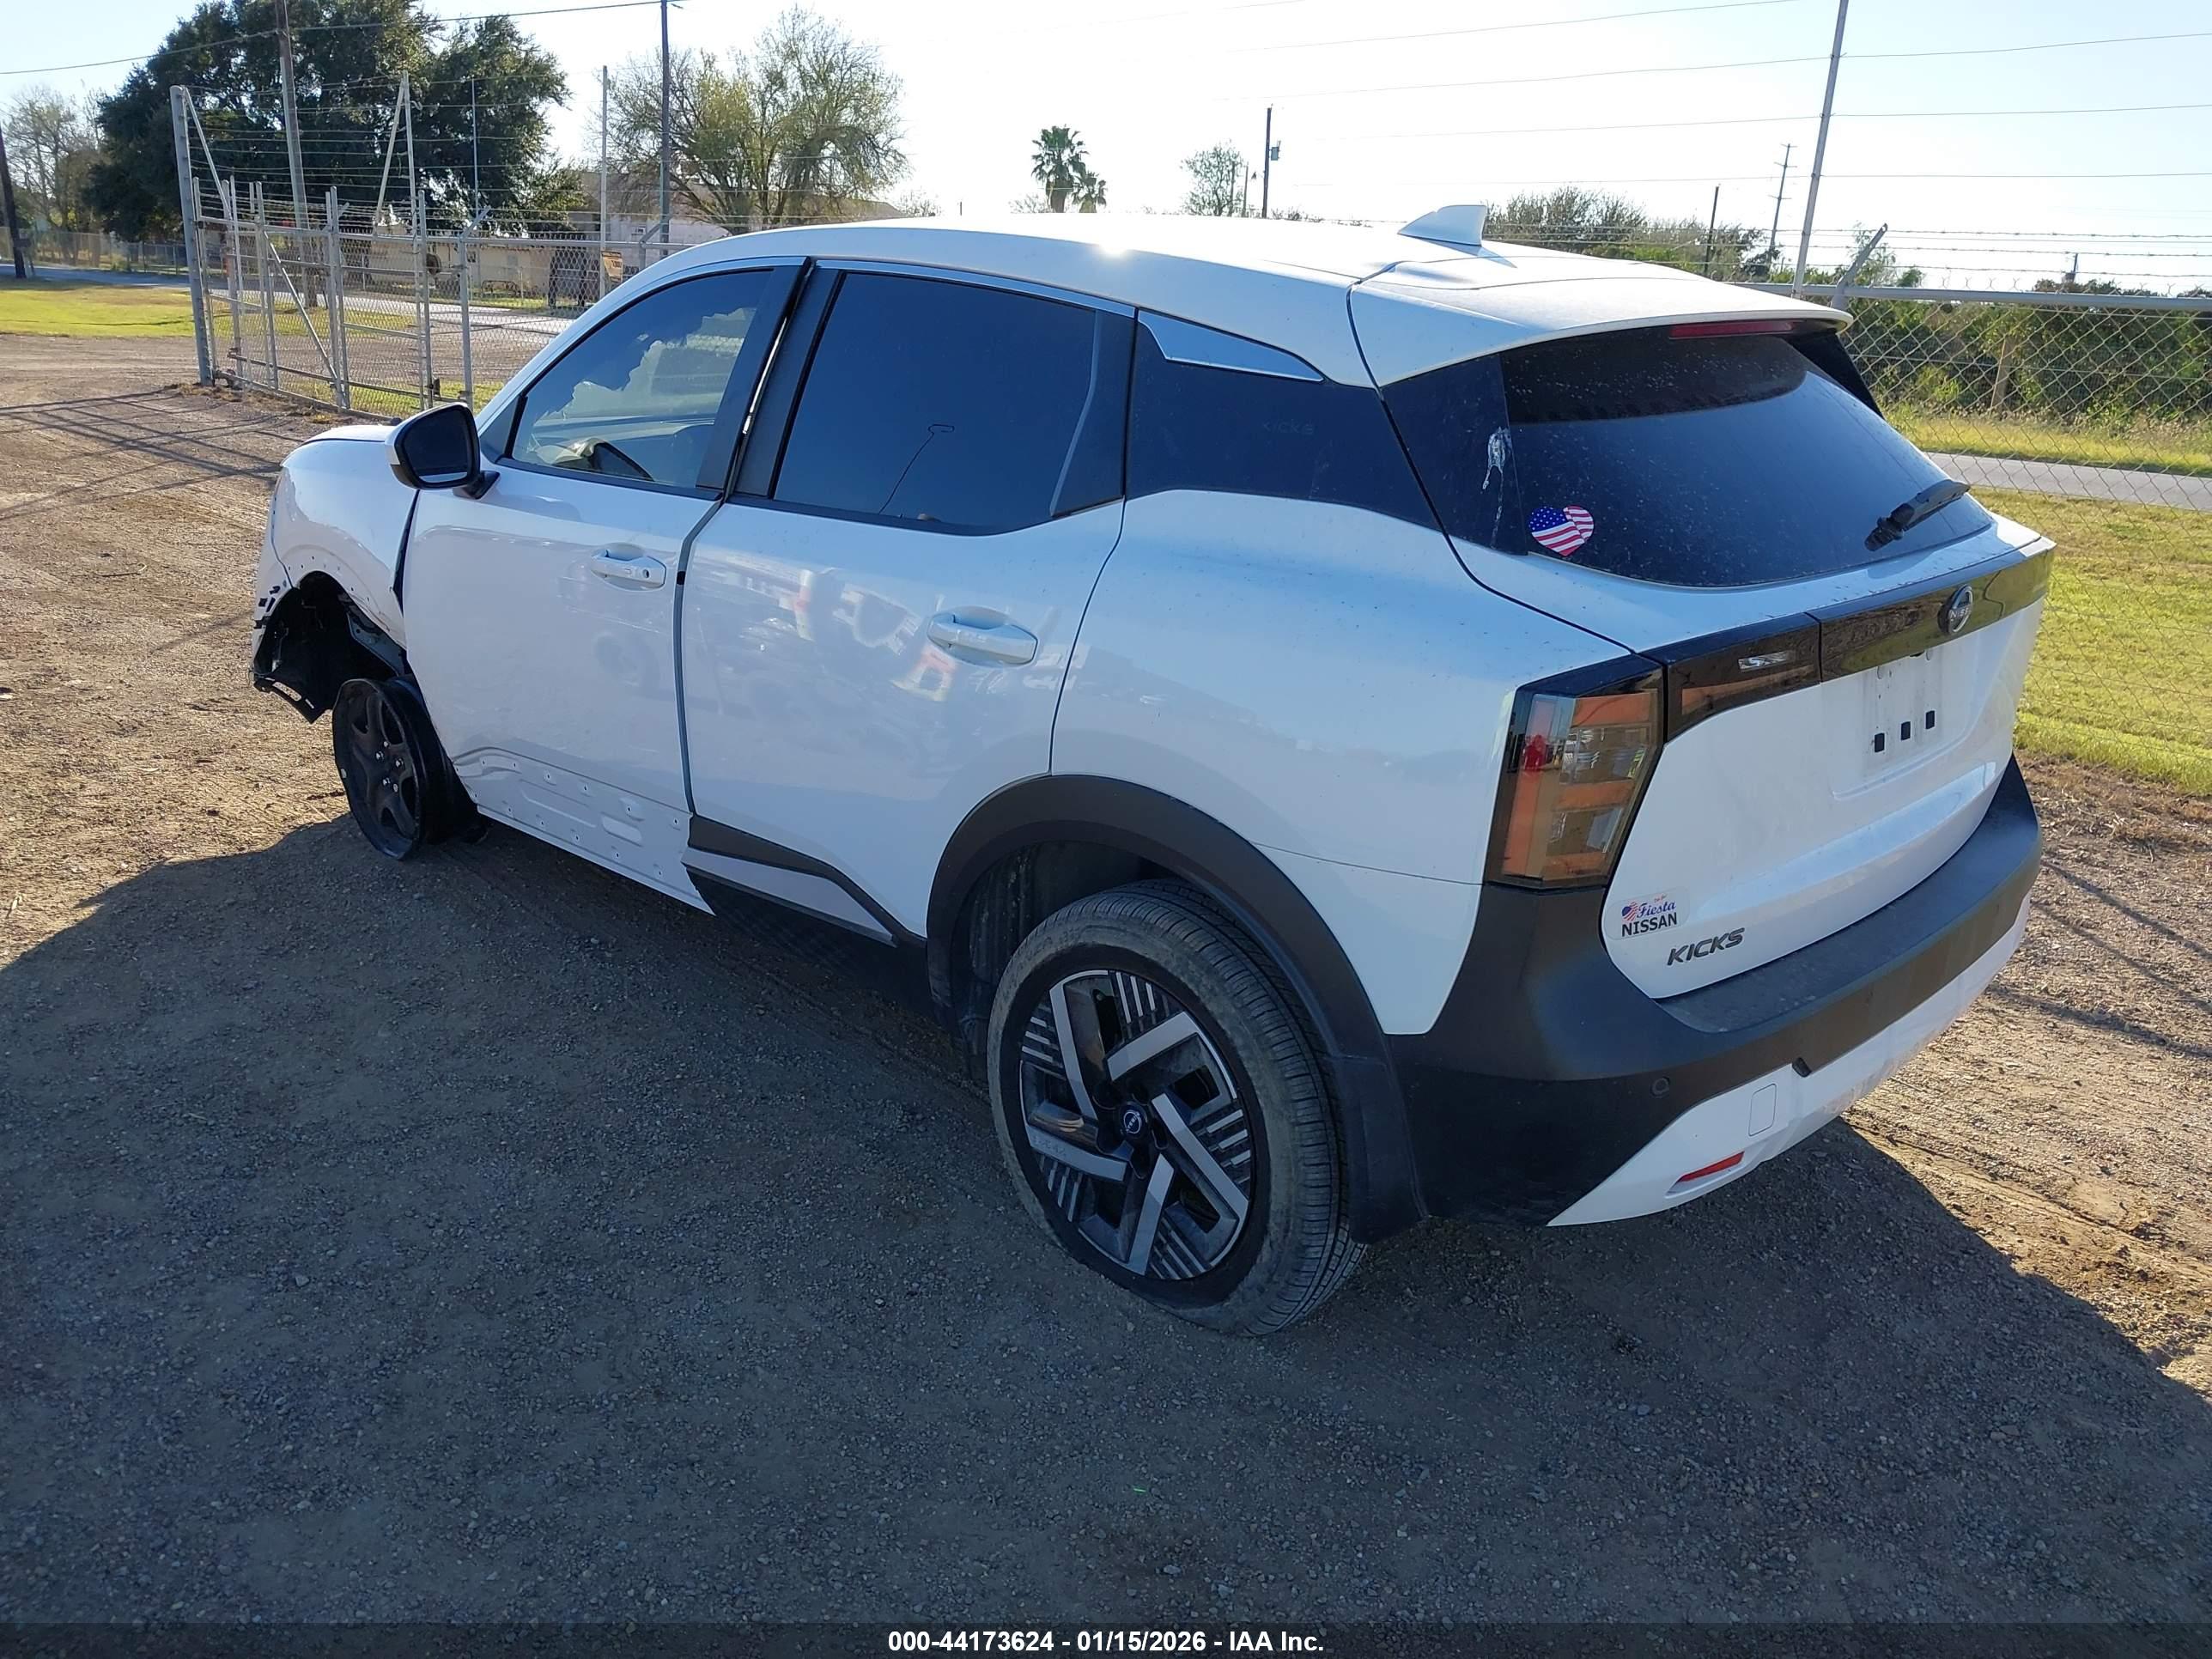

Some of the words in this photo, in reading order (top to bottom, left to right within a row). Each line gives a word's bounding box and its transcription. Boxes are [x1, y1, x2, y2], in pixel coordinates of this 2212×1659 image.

[1637, 901, 1676, 918] Fiesta
[1622, 912, 1678, 937] NISSAN
[1667, 927, 1746, 966] KICKS
